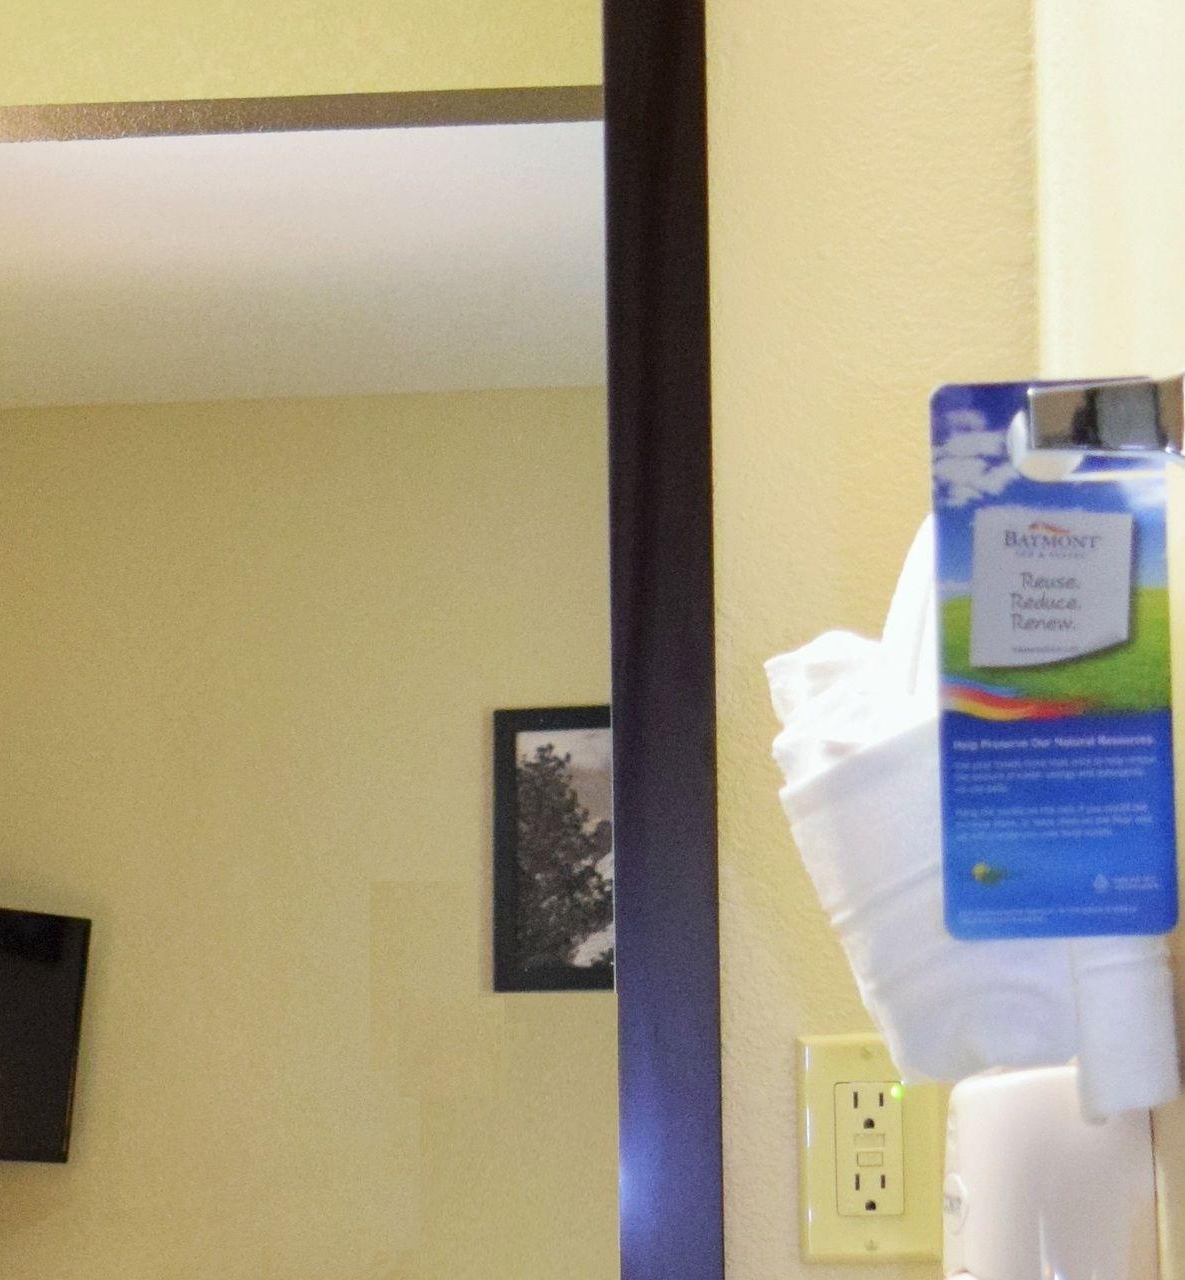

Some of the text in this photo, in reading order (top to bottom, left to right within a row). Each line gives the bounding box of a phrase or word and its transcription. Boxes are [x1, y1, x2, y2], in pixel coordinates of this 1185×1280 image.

[1020, 571, 1080, 590] Reuse.
[1010, 591, 1081, 610] Reduce.
[1010, 612, 1076, 631] Renew.
